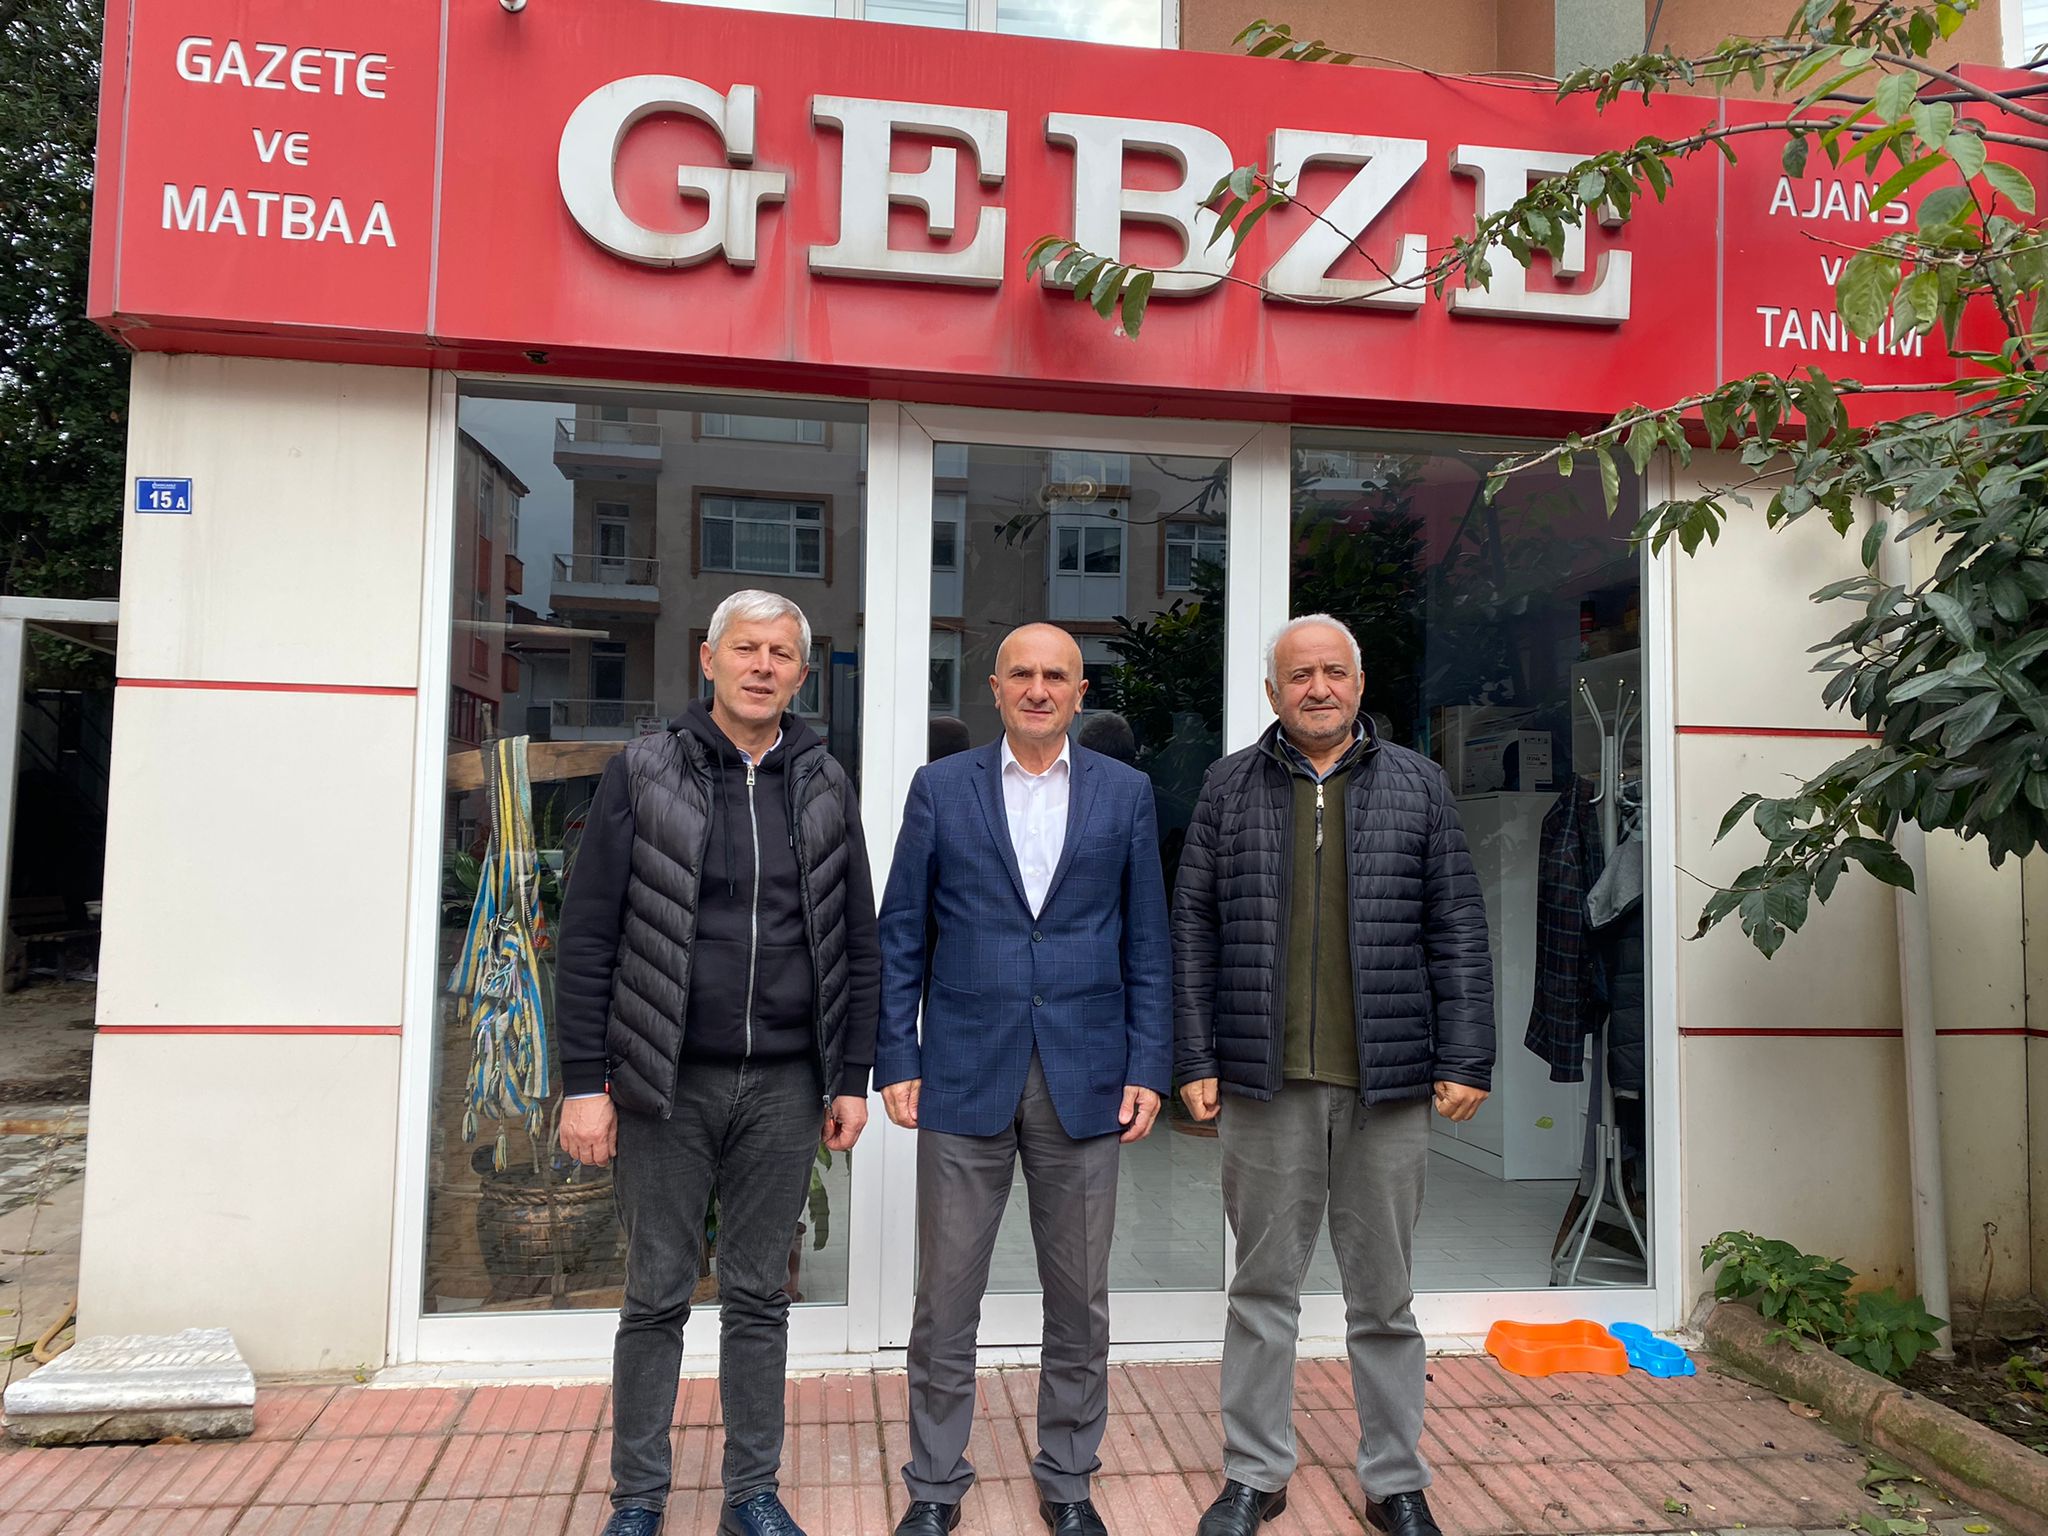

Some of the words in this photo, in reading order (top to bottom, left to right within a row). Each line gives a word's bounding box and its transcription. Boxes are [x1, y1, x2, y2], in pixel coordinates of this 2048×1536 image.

[175, 36, 388, 99] GAZETE
[252, 127, 309, 166] VE
[161, 182, 397, 248] MATBAA
[557, 74, 1634, 326] GEBZE
[1820, 254, 1852, 286] V
[149, 490, 173, 509] 15
[176, 496, 186, 509] A
